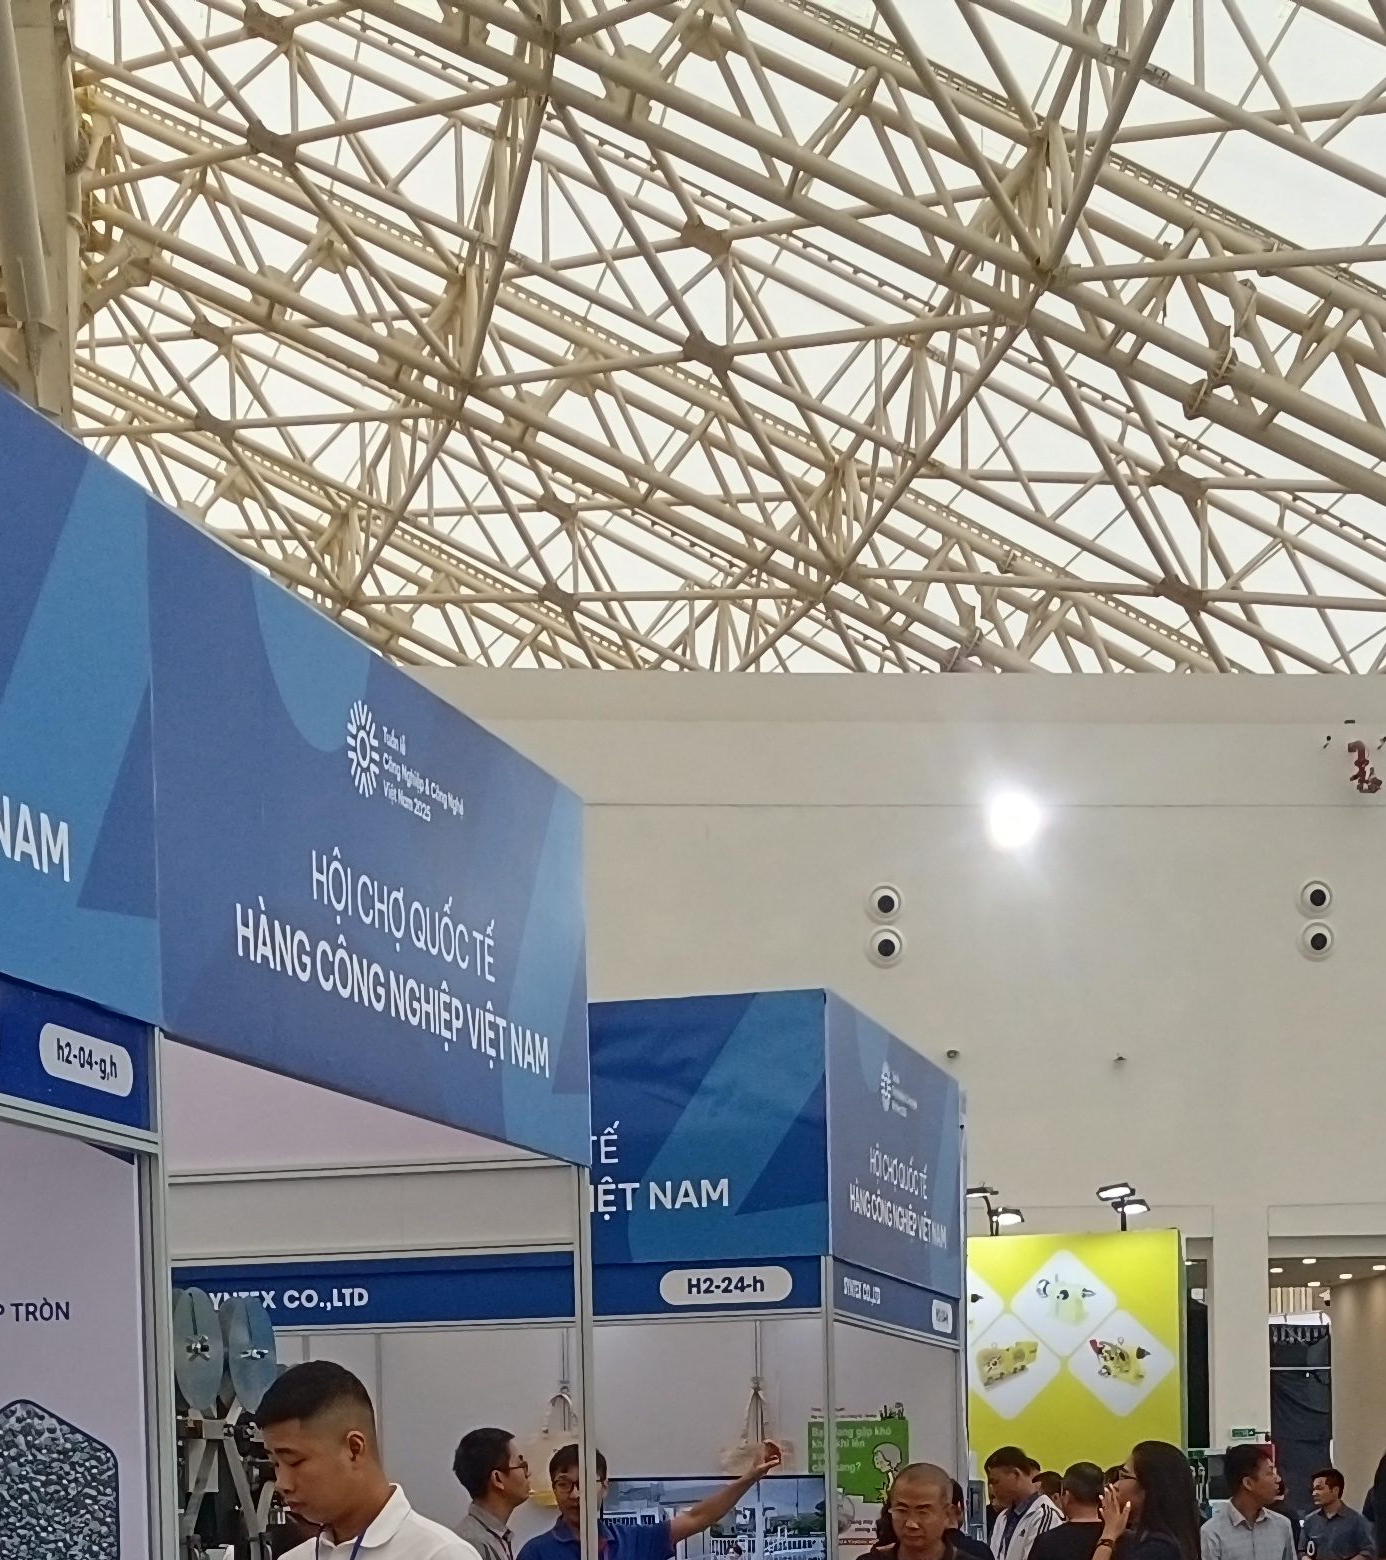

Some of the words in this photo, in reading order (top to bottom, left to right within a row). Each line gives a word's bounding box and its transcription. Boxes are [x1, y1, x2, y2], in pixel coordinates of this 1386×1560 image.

[414, 797, 431, 822] 2025
[311, 846, 352, 925] HỘI
[357, 874, 405, 952] CHỢ
[409, 896, 469, 970] QUỐC
[472, 918, 496, 983] TẾ
[235, 895, 312, 983] HÀNG
[316, 934, 386, 1013] CÔNG
[389, 968, 464, 1052] NGHIỆP
[467, 1000, 507, 1069] VIỆT
[510, 1021, 550, 1079] NAM
[55, 1036, 119, 1082] h2-04-g,h
[590, 1175, 640, 1221] IỆT
[649, 1178, 729, 1210] NAM
[283, 1287, 369, 1311] CO.,LTD
[686, 1276, 765, 1295] H2-24-h
[10, 1296, 71, 1323] TRÒN
